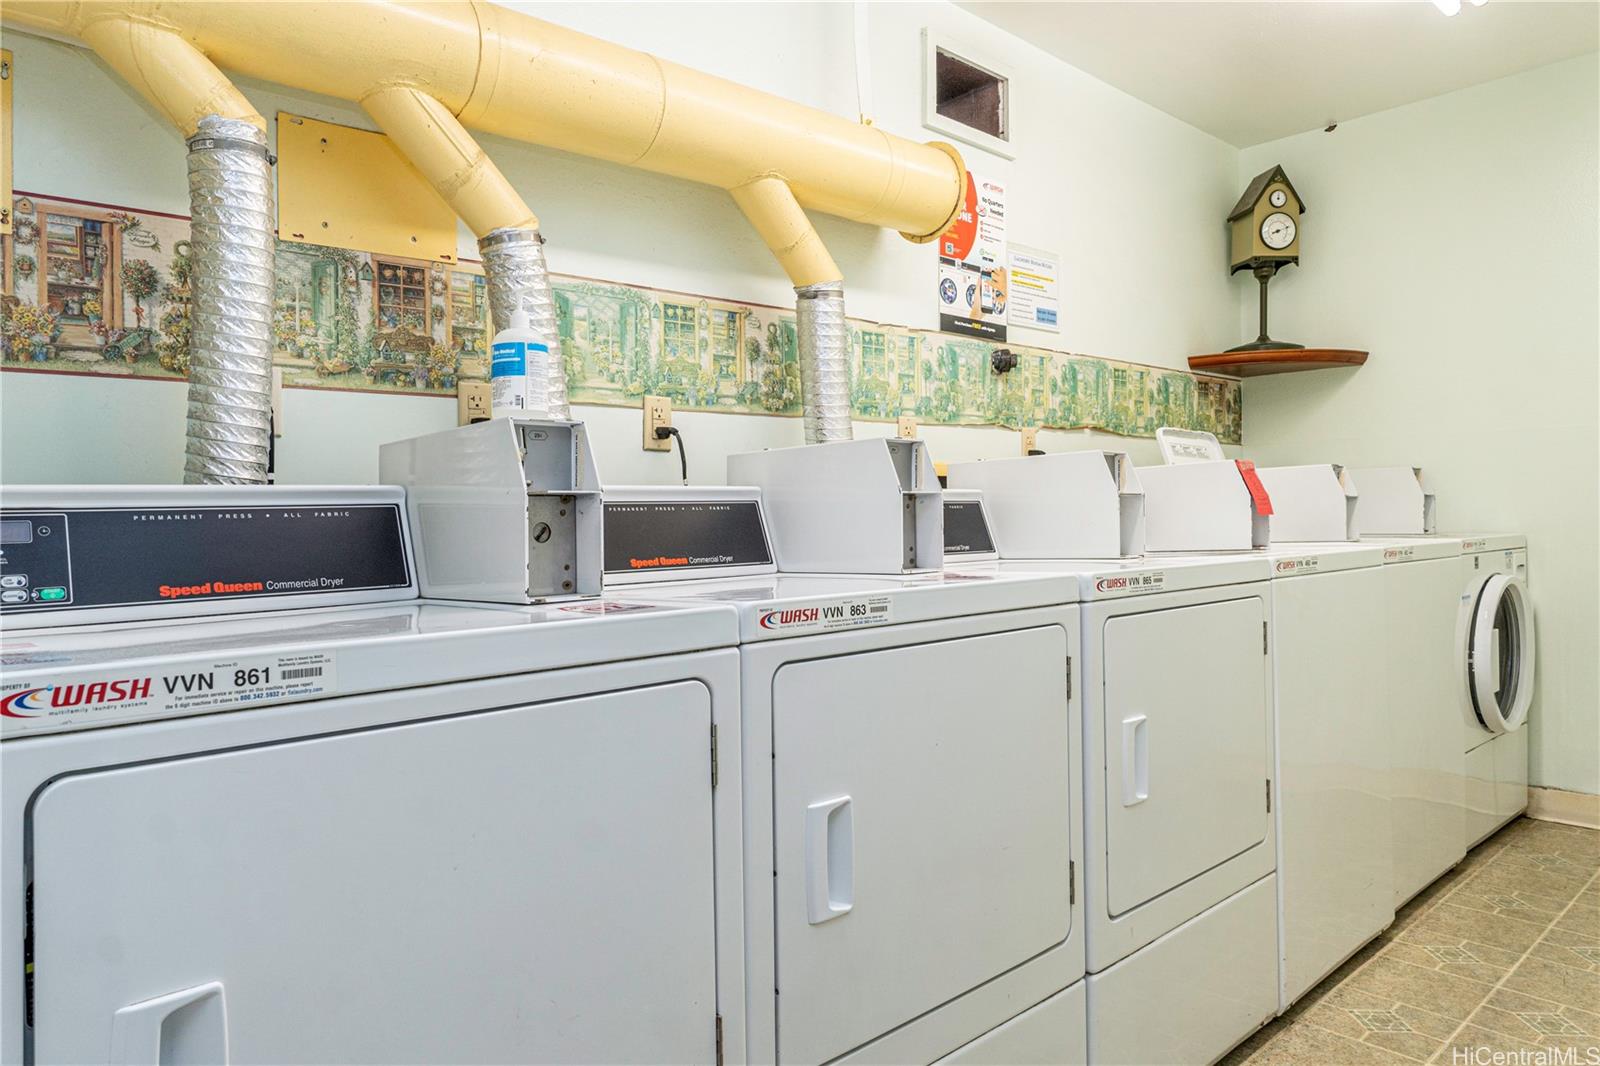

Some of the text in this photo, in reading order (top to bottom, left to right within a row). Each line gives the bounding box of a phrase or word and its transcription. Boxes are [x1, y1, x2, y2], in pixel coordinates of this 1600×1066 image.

[133, 513, 203, 521] PERMANENT
[630, 555, 734, 568] Speed Queen Commercial Dryer
[159, 576, 344, 598] Speed Queen Commercial Dryer
[1106, 578, 1127, 588] WASH
[1128, 577, 1140, 585] VVN
[1142, 576, 1152, 585] 865
[780, 608, 819, 623] WASH
[823, 606, 843, 618] VVN
[850, 604, 866, 616] 863
[51, 667, 270, 707] WASH VVN 861
[49, 707, 88, 716] multifamily
